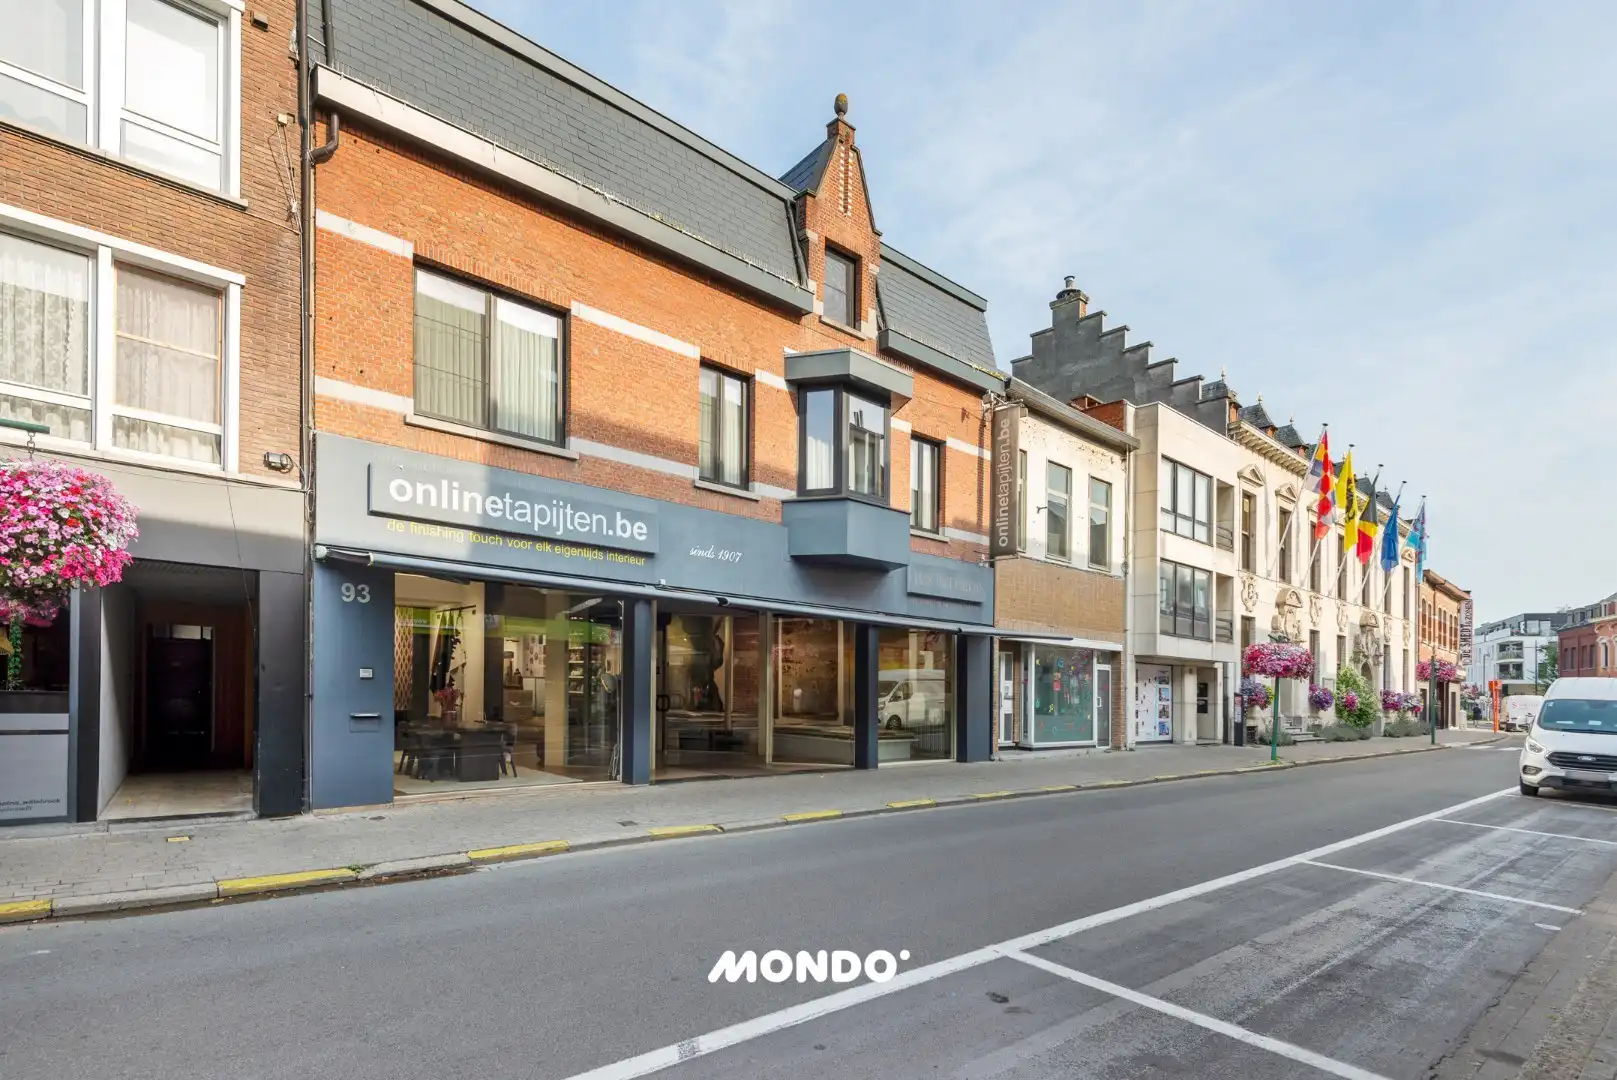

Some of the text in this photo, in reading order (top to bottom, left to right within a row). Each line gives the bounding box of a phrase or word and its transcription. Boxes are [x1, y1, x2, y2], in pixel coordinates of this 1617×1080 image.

[996, 418, 1012, 547] onlinetapijten.be
[389, 478, 648, 541] onlinetapijten.be
[387, 519, 645, 566] de finishing touch voor elk eigentijds interieur
[689, 545, 743, 563] sinds 1907
[340, 583, 372, 604] 93
